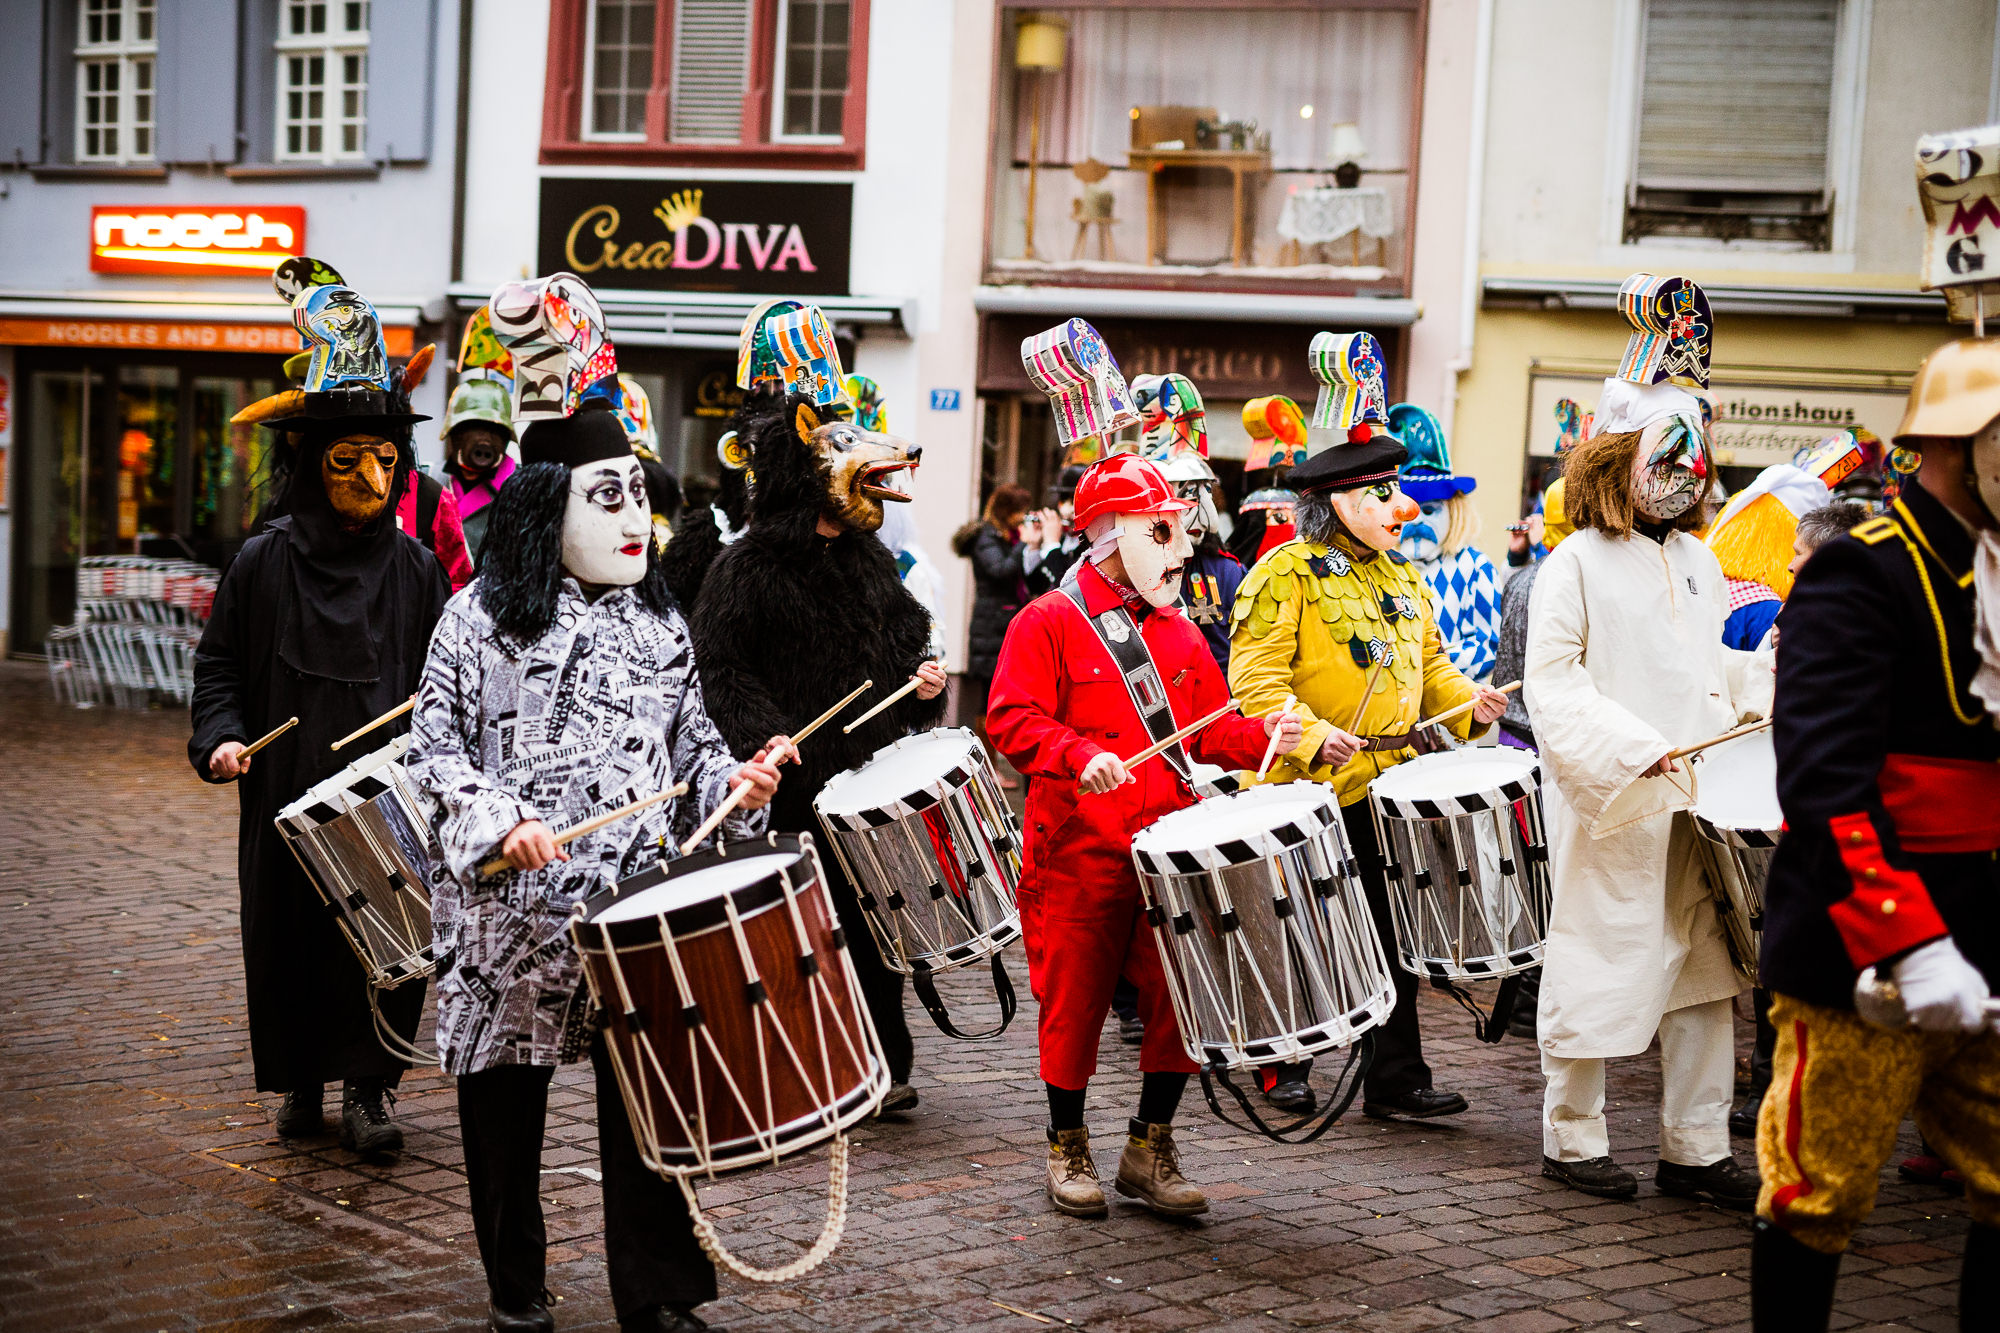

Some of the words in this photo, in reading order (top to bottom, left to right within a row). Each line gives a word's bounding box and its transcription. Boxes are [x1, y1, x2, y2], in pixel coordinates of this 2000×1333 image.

[95, 213, 294, 249] nooch
[565, 204, 818, 273] CreaDIVA
[48, 324, 159, 344] NOODLES
[166, 327, 218, 346] AND
[224, 329, 297, 349] MORE
[1122, 347, 1283, 381] araco
[936, 391, 956, 408] 77
[1723, 398, 1856, 421] tionshaus
